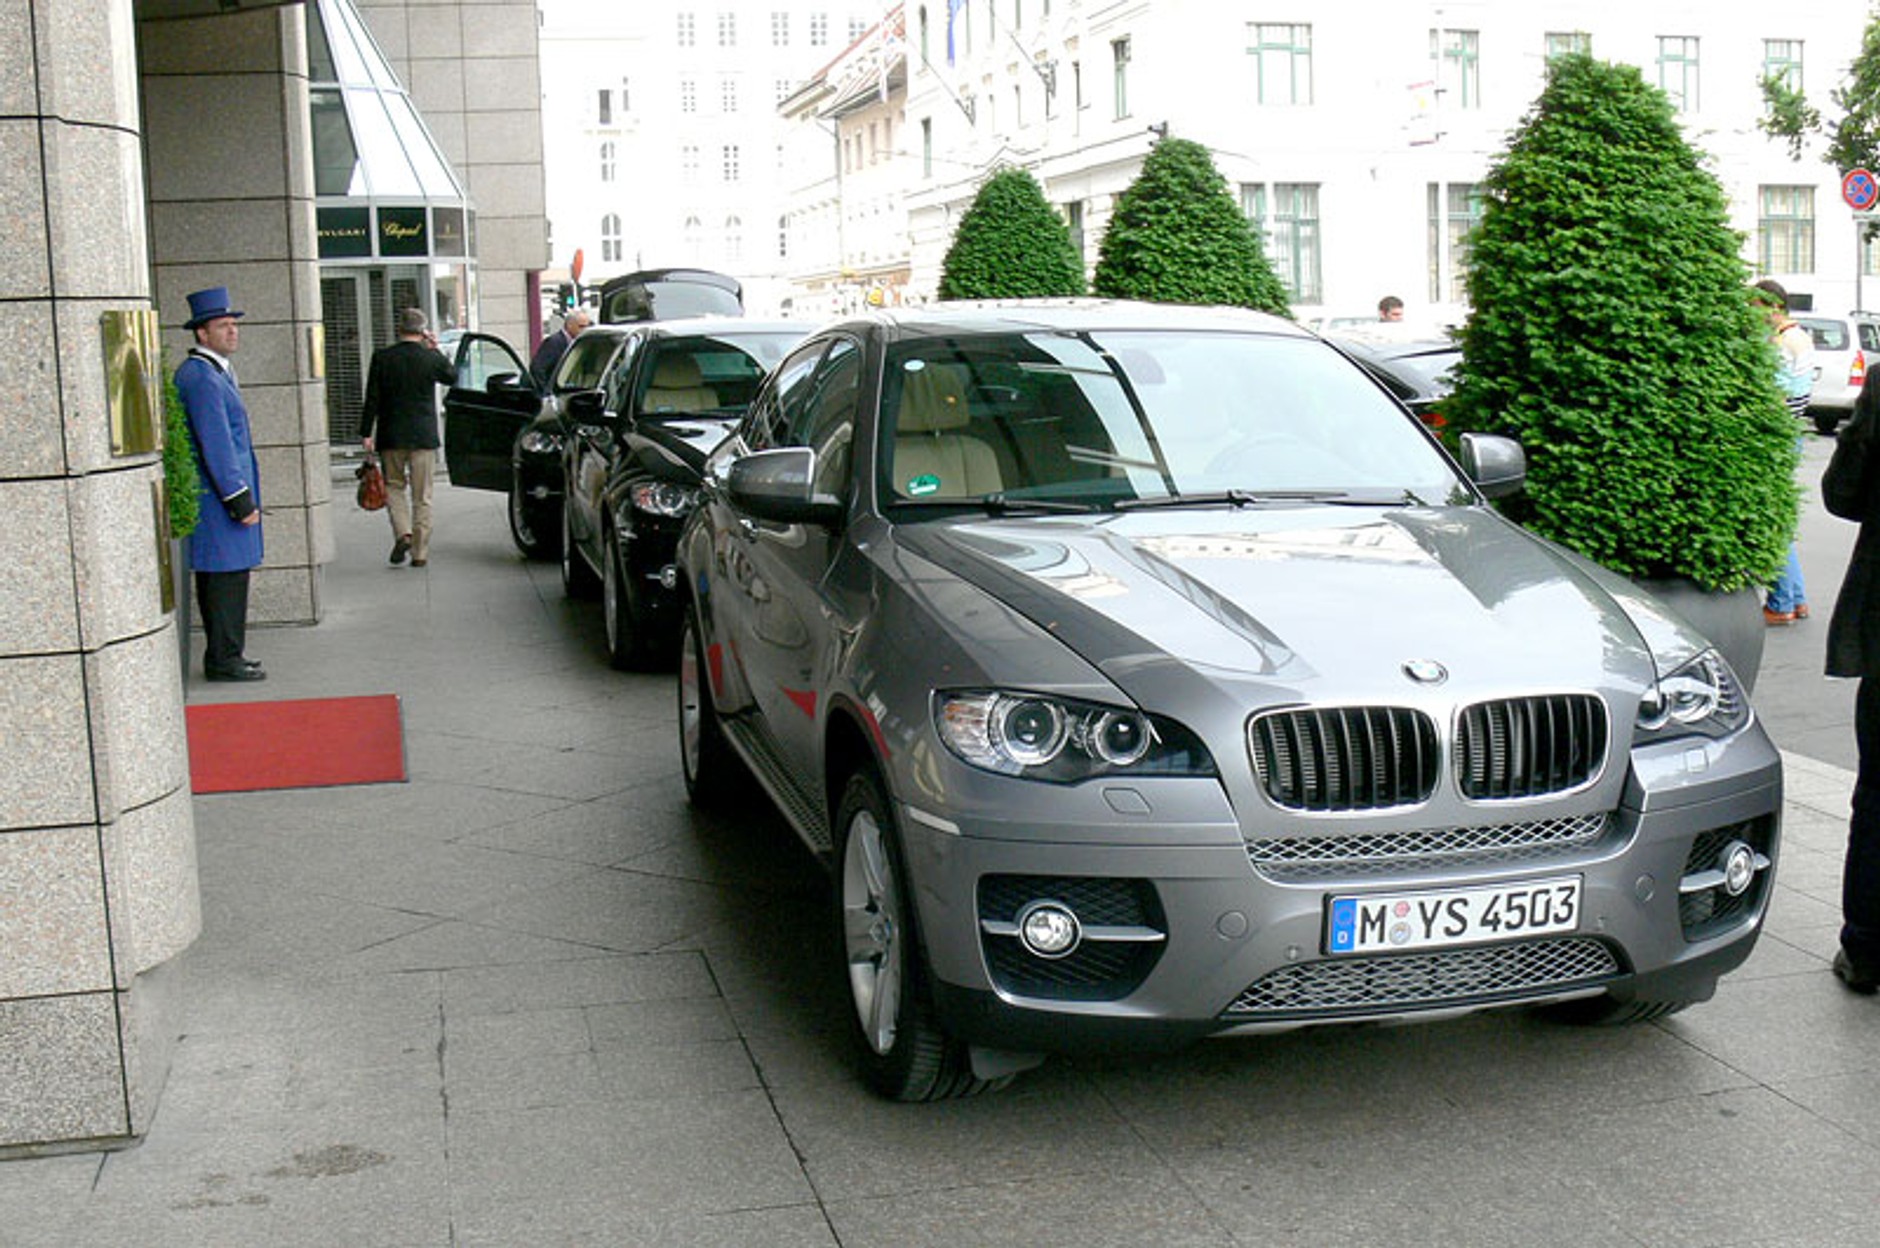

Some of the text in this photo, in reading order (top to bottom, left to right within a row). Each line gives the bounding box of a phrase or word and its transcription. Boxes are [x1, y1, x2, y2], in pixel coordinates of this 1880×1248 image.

[1360, 905, 1387, 944] M
[1418, 898, 1468, 939] YS
[1480, 886, 1576, 932] 4503
